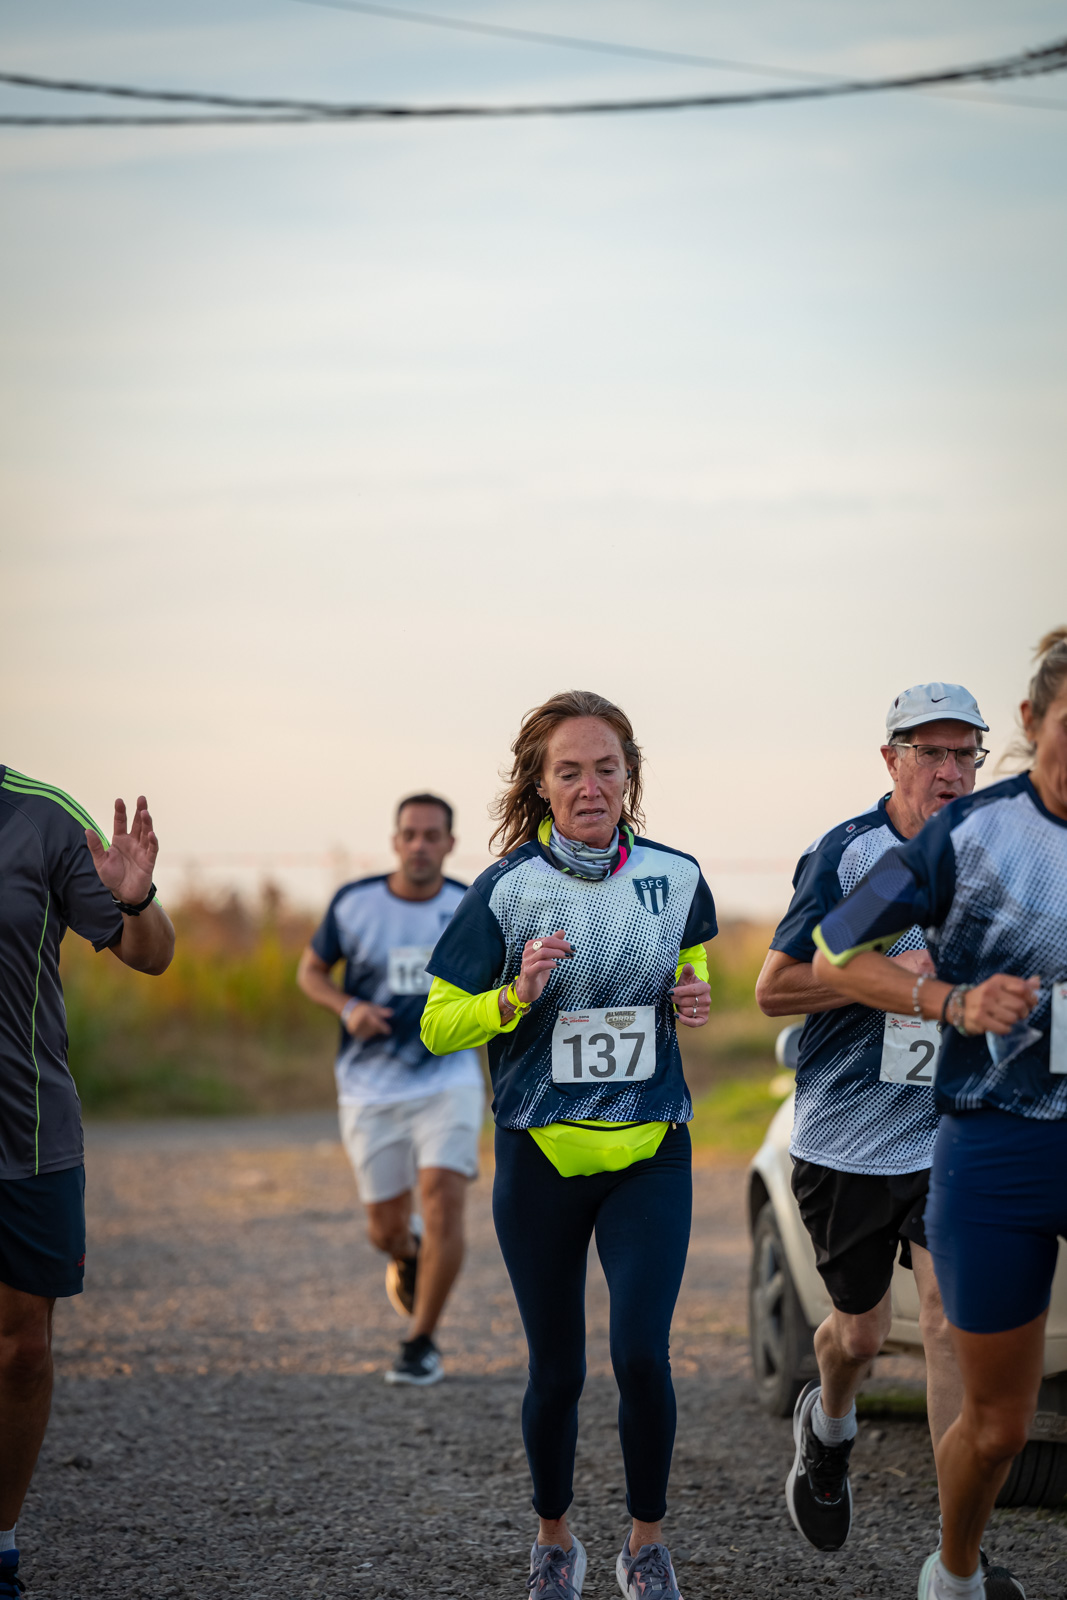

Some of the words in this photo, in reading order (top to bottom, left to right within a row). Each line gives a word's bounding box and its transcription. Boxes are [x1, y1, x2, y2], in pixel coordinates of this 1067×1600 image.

[640, 879, 663, 889] SFC
[397, 962, 428, 992] 16
[563, 1032, 645, 1078] 137
[906, 1040, 942, 1082] 2
